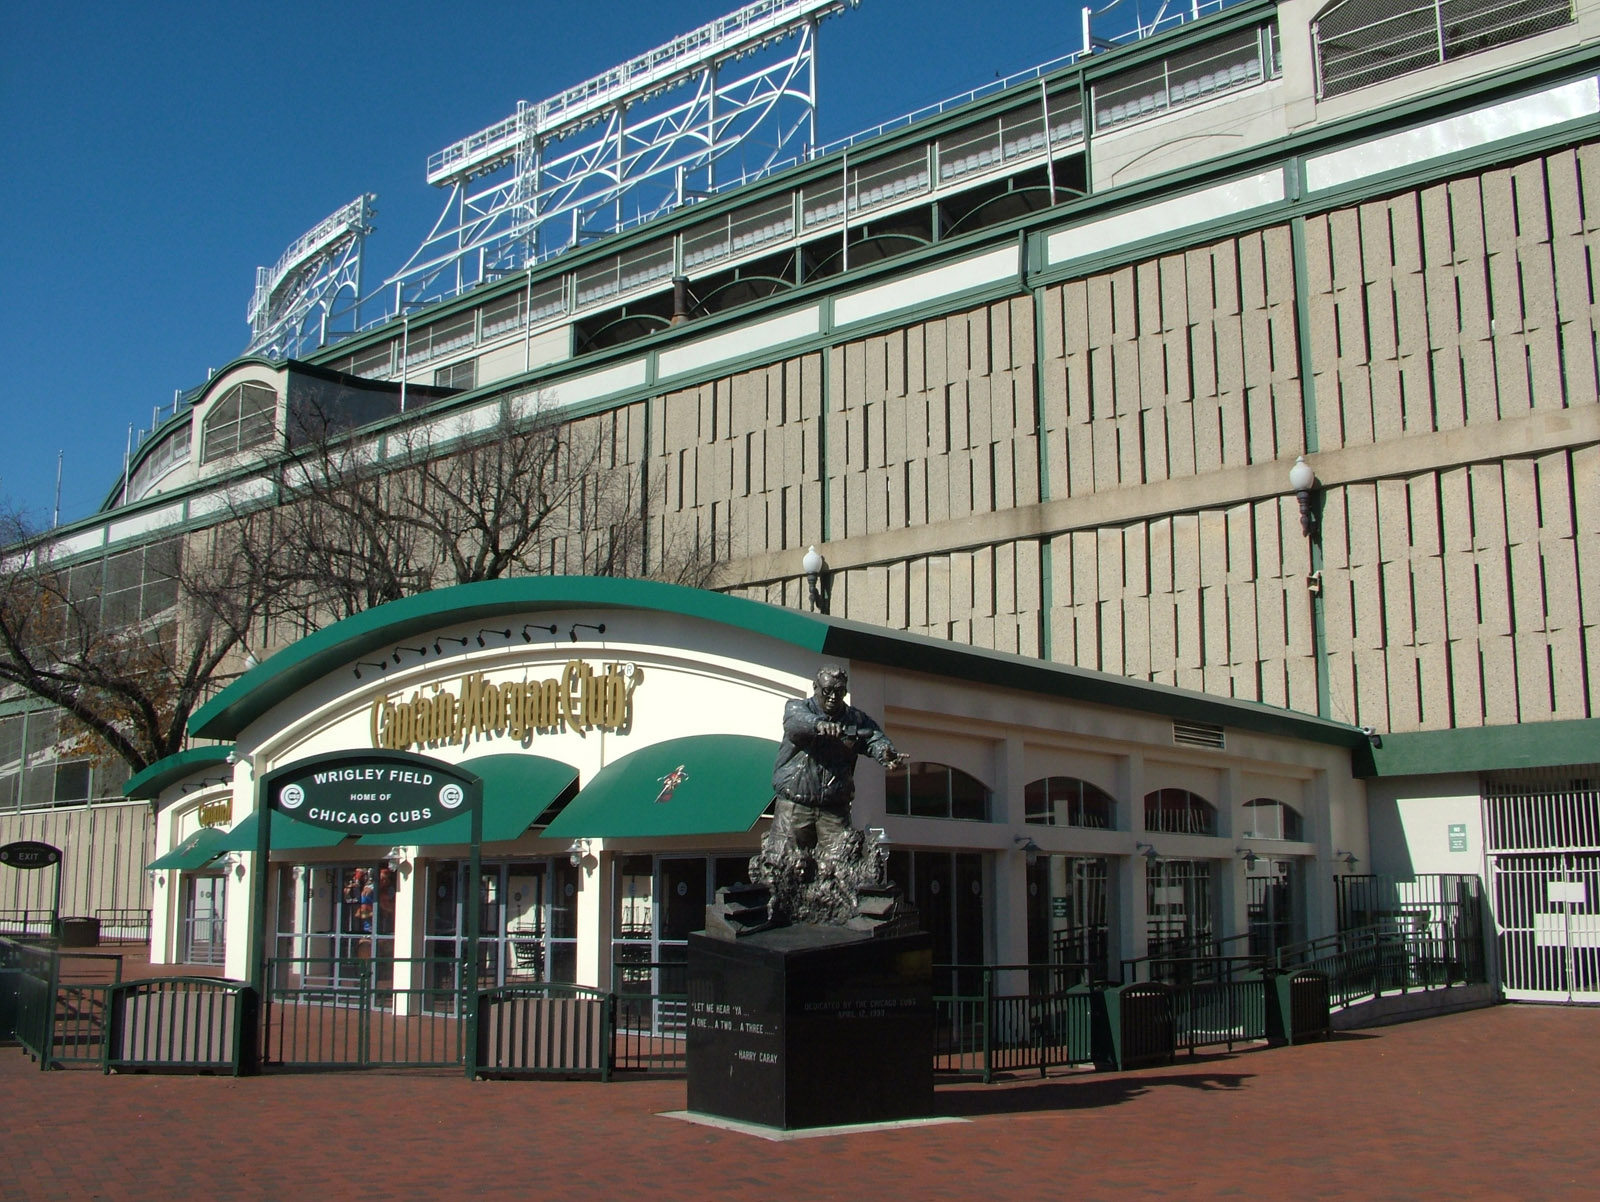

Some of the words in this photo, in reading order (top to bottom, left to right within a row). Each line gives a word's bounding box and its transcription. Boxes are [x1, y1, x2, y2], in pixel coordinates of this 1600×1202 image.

[369, 682, 456, 750] Captain
[454, 672, 559, 741] Morgan
[560, 659, 626, 733] Club
[313, 768, 385, 784] WRIGLEY
[389, 770, 433, 786] FIELD
[350, 793, 377, 801] HOME
[379, 793, 392, 801] OF
[308, 807, 382, 825] CHICAGO
[388, 807, 432, 823] CUBS
[18, 852, 39, 861] EXIT
[706, 1003, 714, 1013] ME
[716, 1004, 731, 1015] HEAR
[869, 998, 897, 1008] CHICAGO
[691, 1017, 696, 1026] A
[759, 1051, 778, 1064] CARAY
